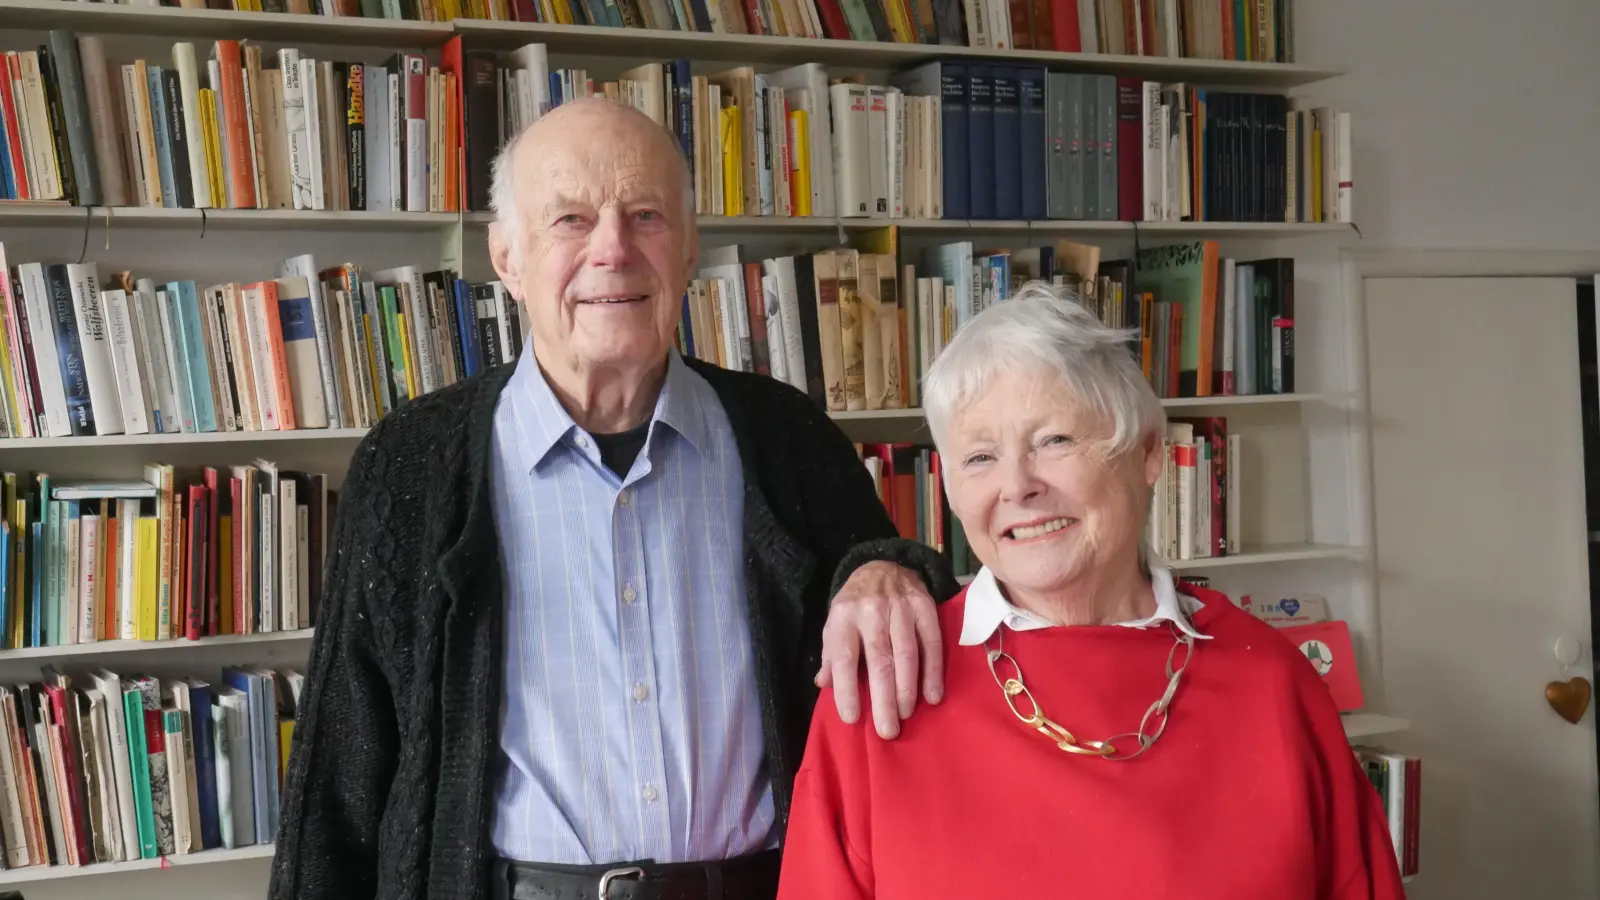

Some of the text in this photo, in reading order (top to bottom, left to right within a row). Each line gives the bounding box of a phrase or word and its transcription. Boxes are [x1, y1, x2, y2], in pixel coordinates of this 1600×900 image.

[348, 64, 364, 124] Handke
[76, 281, 92, 336] Leonie Ossowski
[86, 276, 105, 342] Wolfsbeeren
[66, 353, 75, 376] STEN
[78, 406, 87, 427] PIPER
